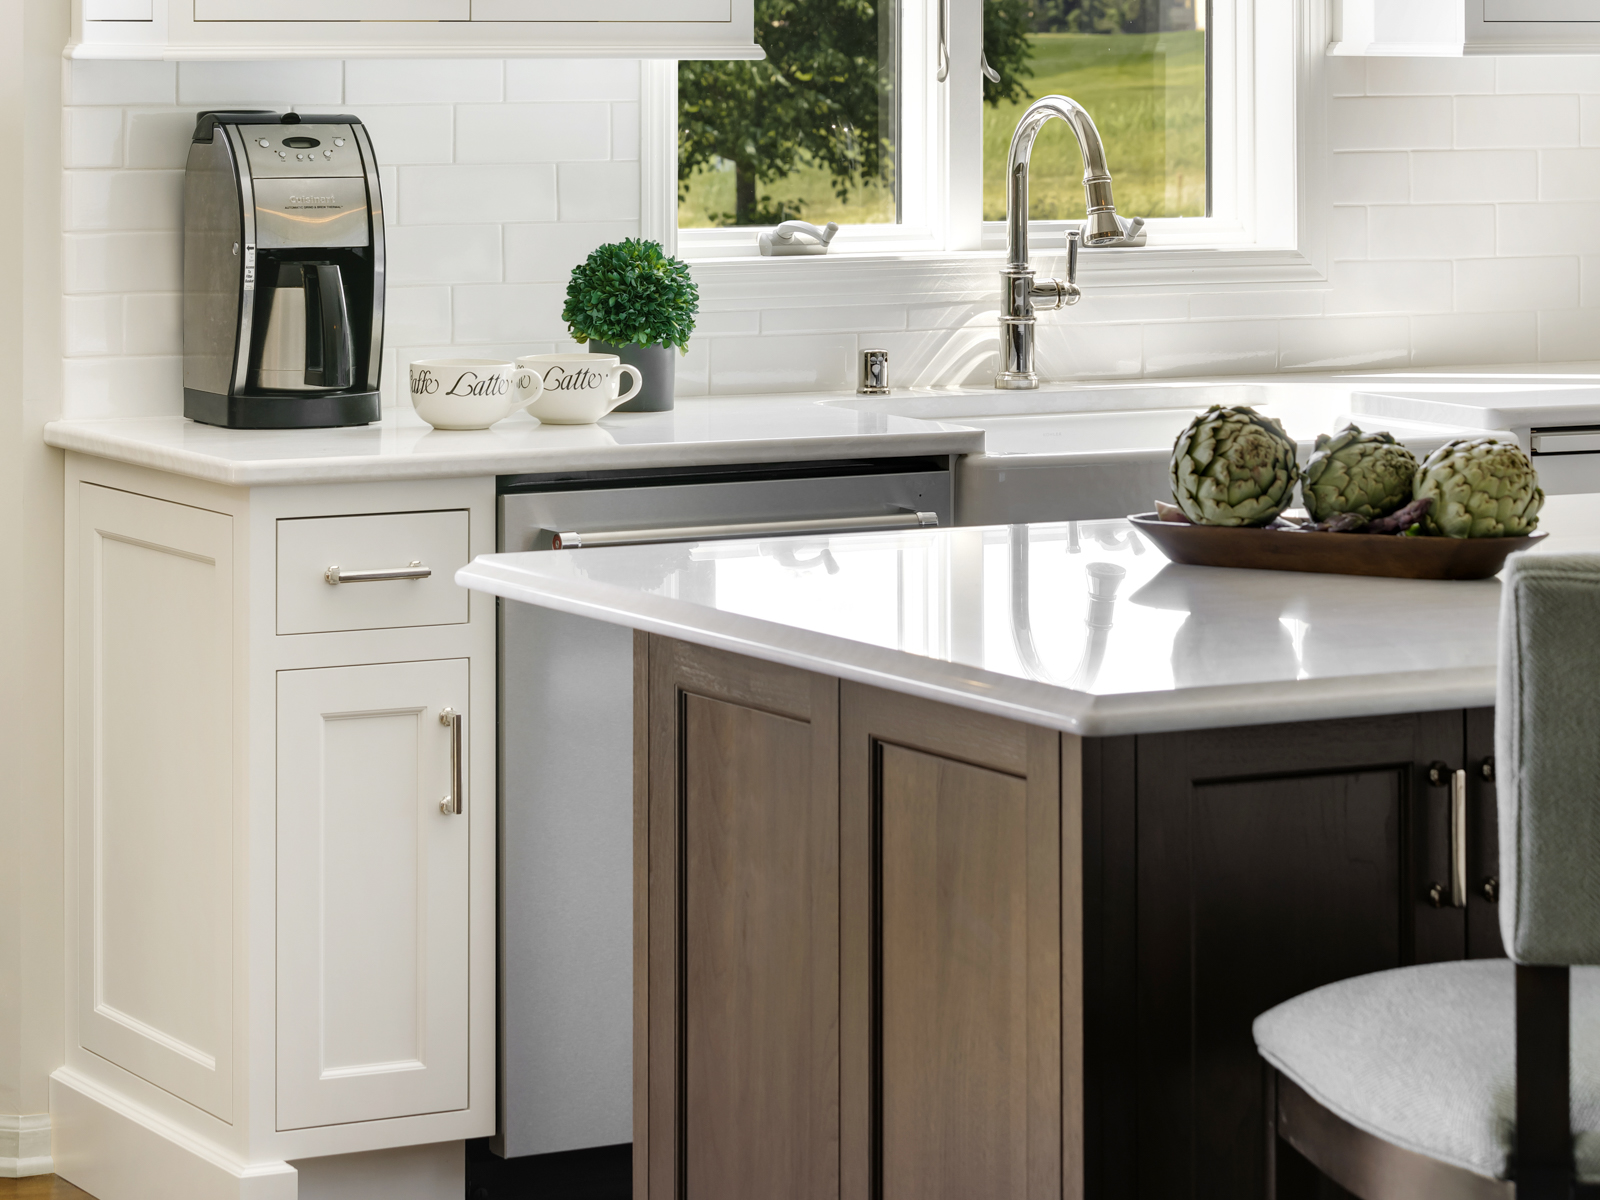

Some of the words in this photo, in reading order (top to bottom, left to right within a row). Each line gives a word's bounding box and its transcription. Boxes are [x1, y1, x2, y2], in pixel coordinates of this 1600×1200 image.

[289, 194, 335, 204] Cuisinart
[445, 371, 509, 397] Latte
[543, 365, 603, 391] Latte
